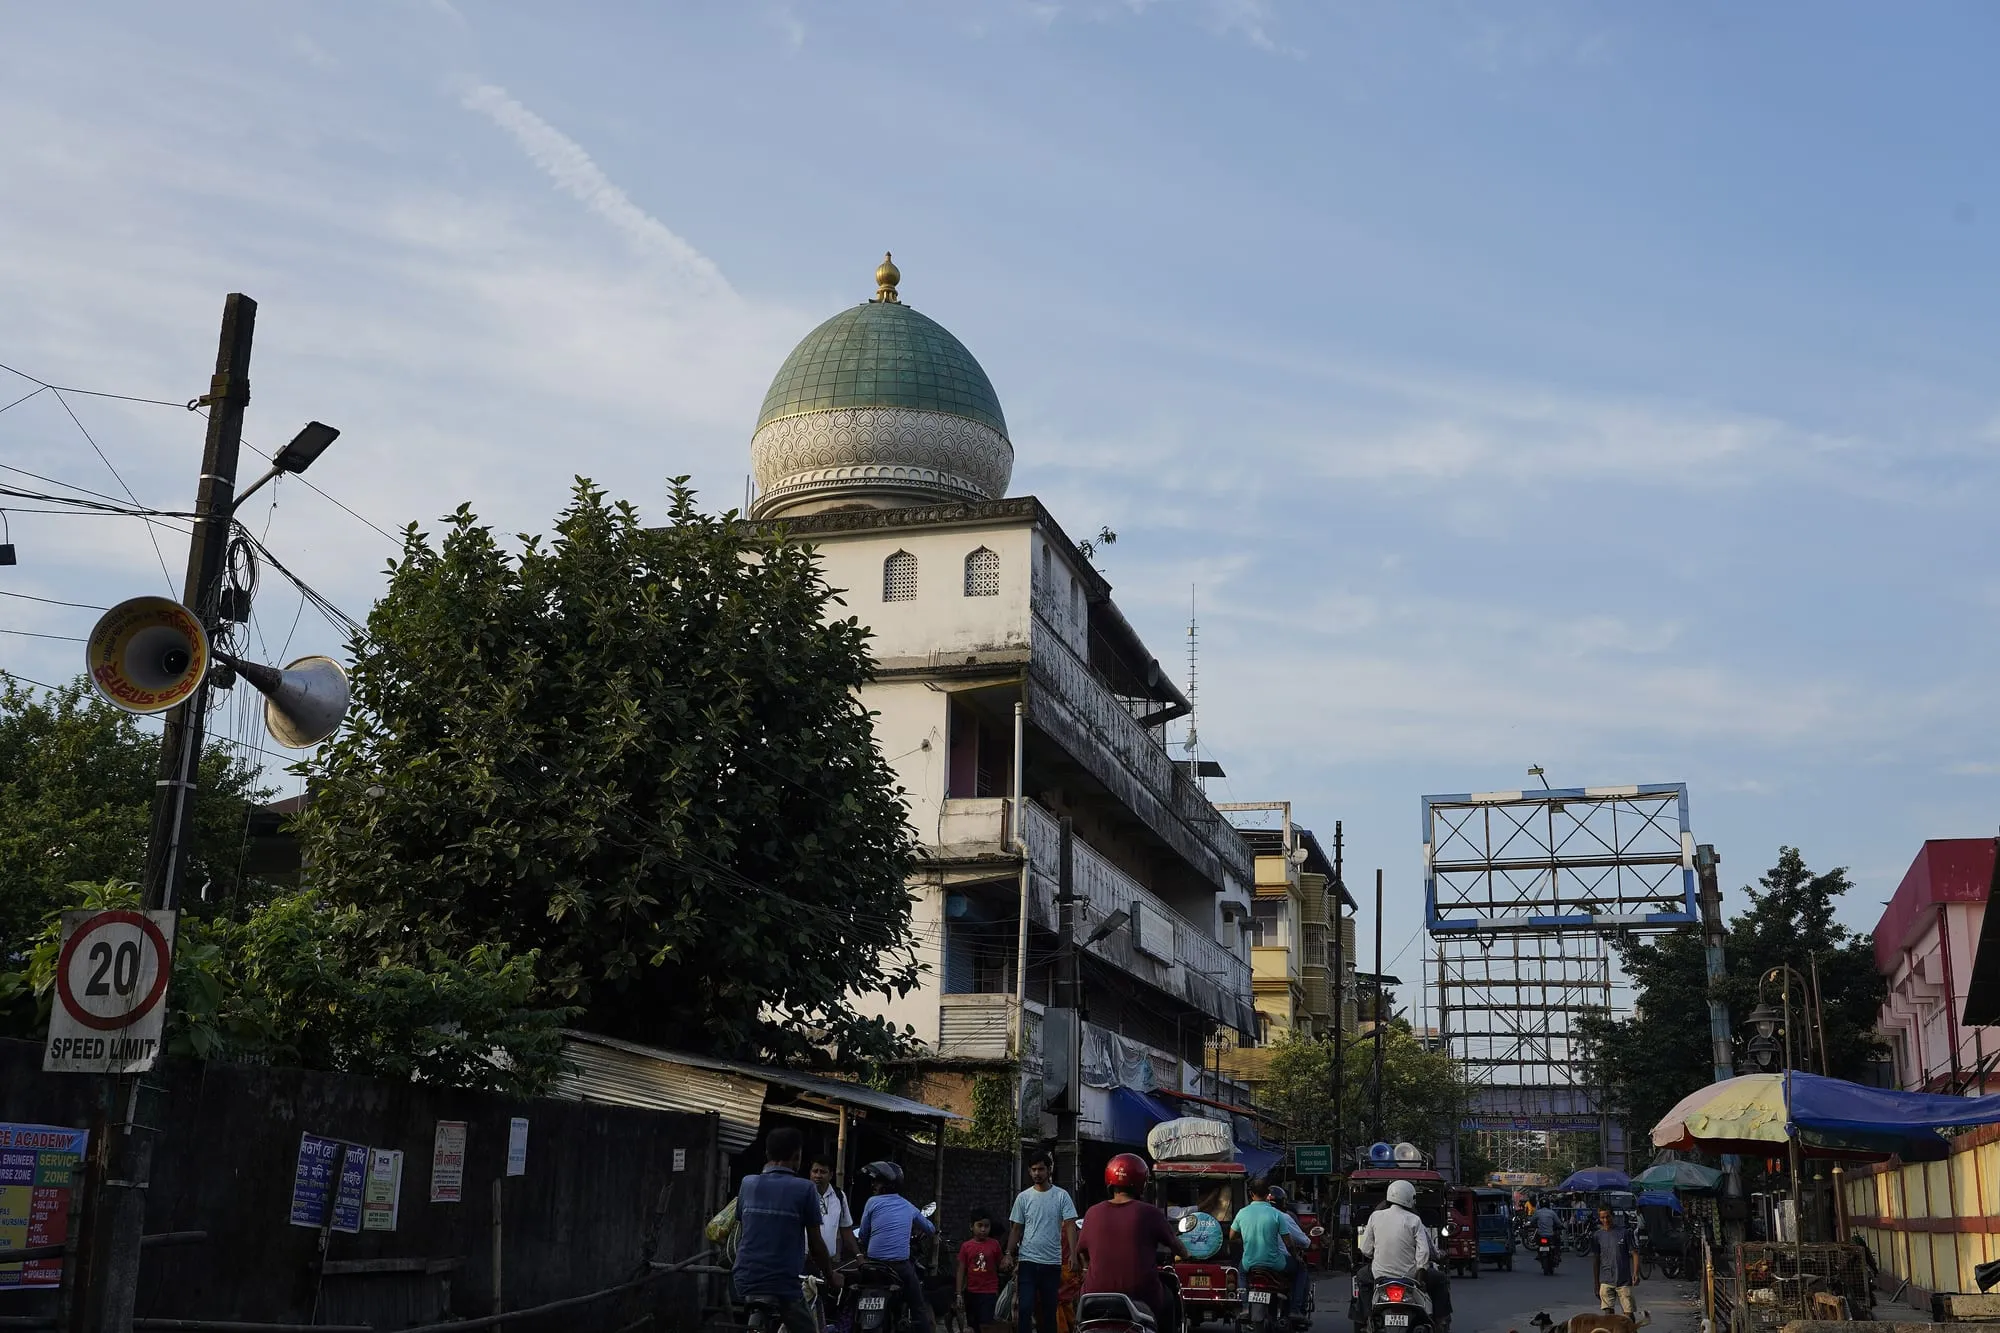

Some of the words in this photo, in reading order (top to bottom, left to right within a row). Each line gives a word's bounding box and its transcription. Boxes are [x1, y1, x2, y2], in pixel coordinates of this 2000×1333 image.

[85, 941, 140, 996] 20
[51, 1037, 104, 1060] SPEED
[109, 1038, 157, 1061] LIMIT
[14, 1131, 75, 1149] ACADEMY
[2, 1153, 35, 1168] ENGINEER,
[14, 1169, 32, 1181] ZONE
[43, 1170, 69, 1184] ZONE
[2, 1218, 29, 1226] NURSING
[32, 1235, 48, 1244] POLICE
